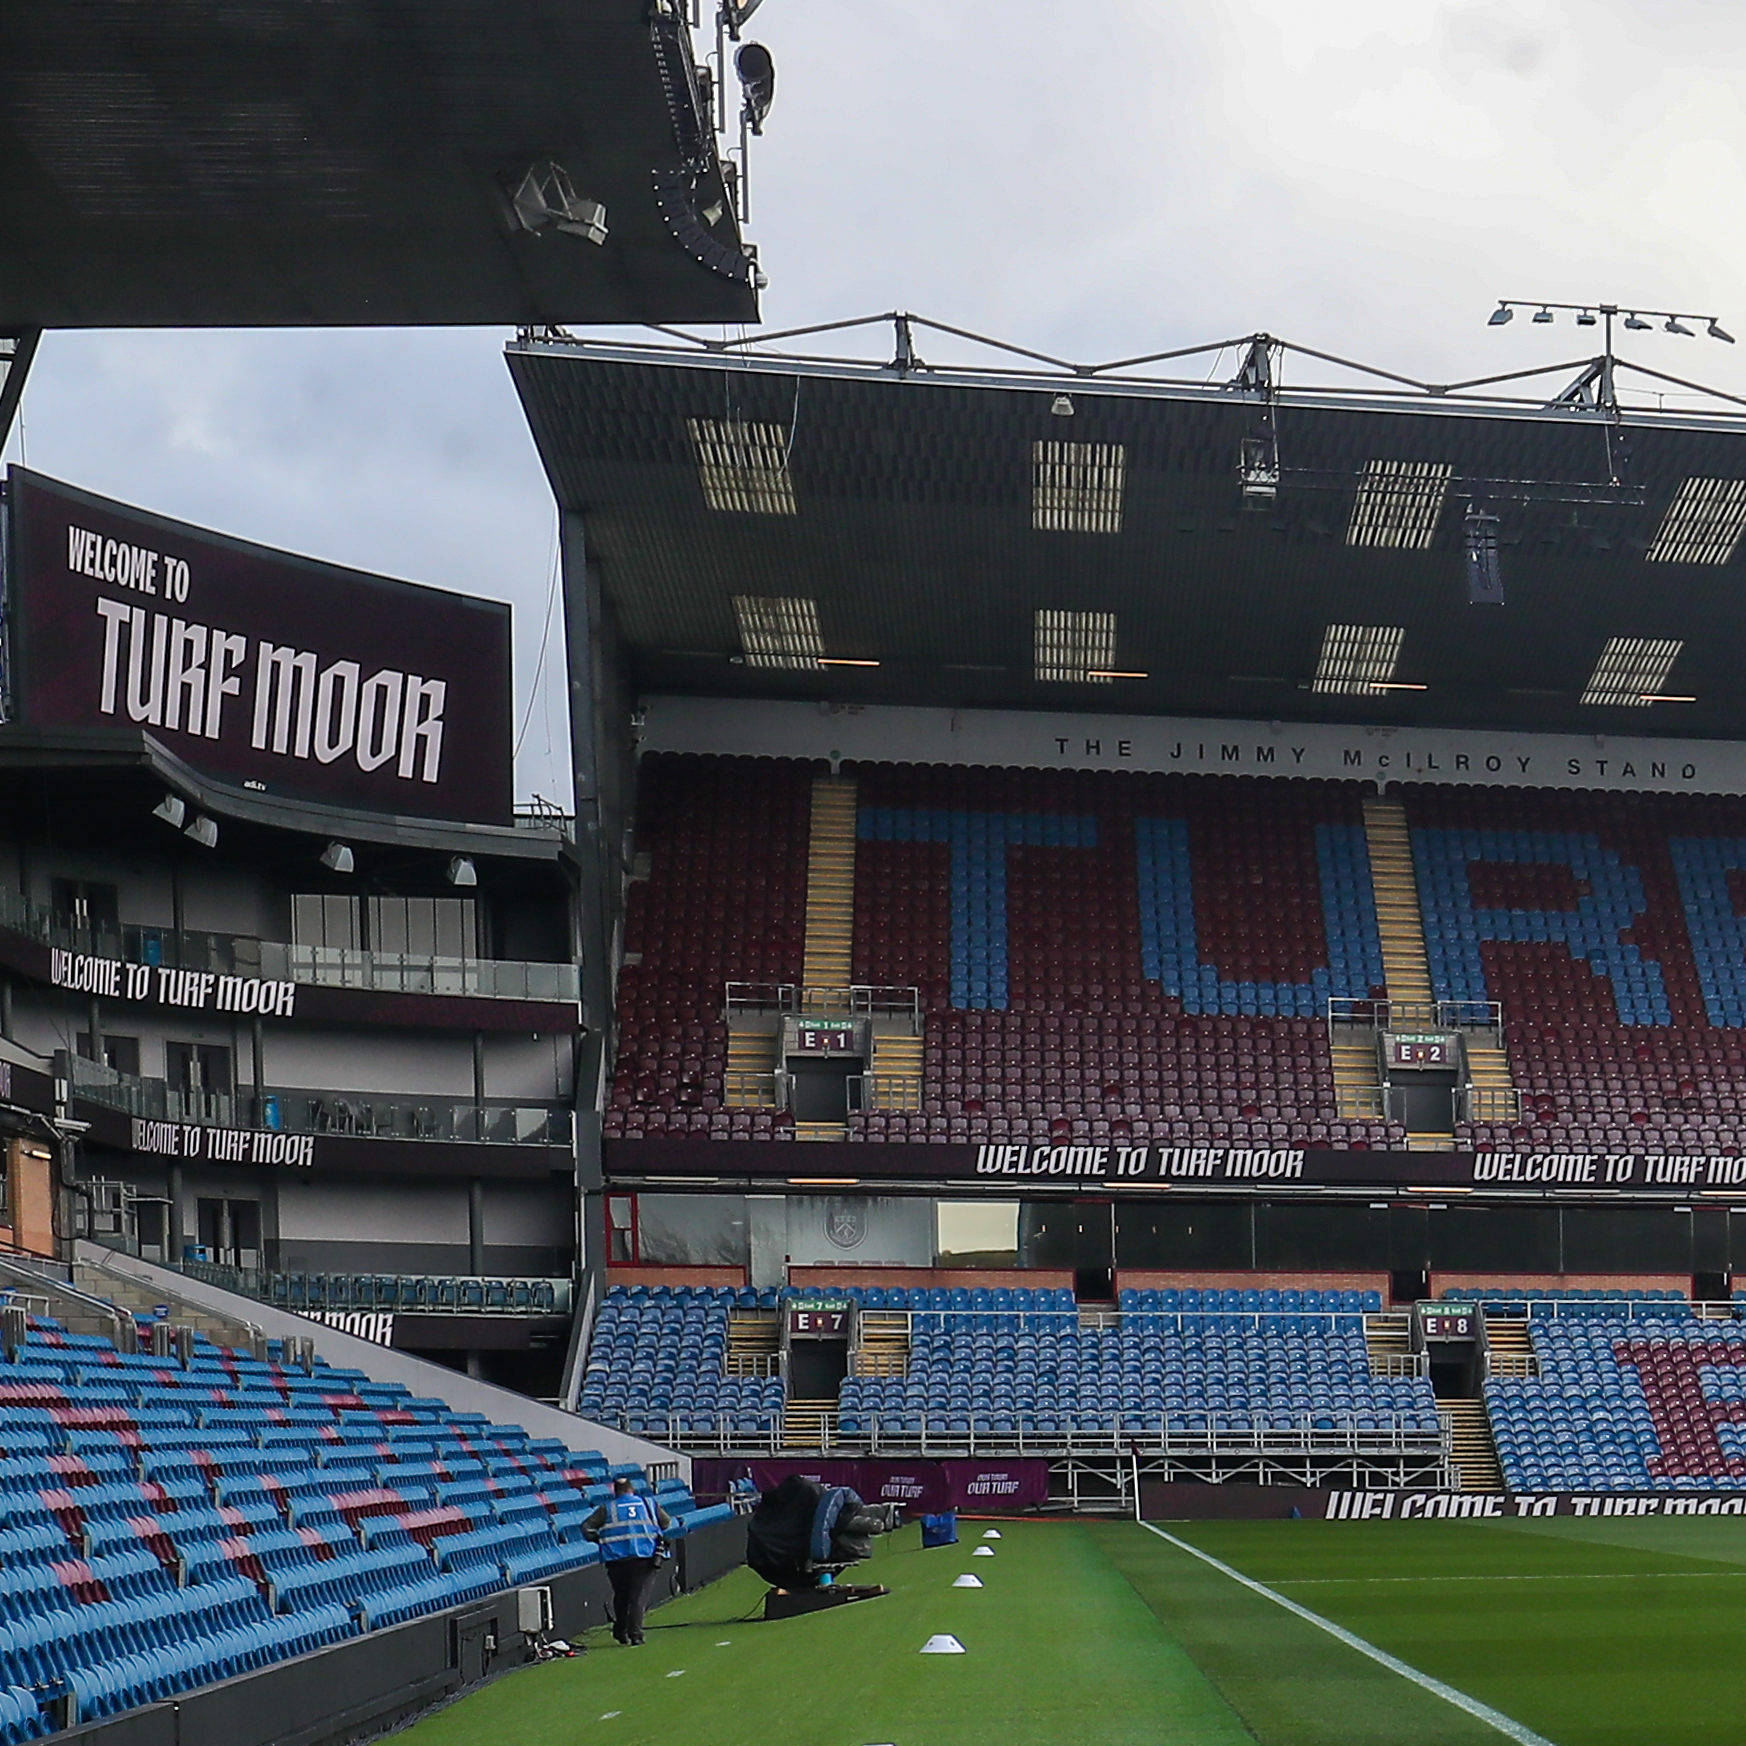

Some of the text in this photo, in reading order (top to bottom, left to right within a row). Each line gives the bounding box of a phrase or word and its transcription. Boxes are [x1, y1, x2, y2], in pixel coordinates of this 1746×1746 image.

[68, 525, 190, 602] WELCOME TO
[97, 597, 446, 783] TURF MOOR
[1055, 738, 1132, 757] THE
[1170, 743, 1305, 763] JIMMY
[1568, 758, 1696, 779] STAND
[51, 947, 296, 1017] WELCOME TO TURF MOOR
[805, 1032, 845, 1048] E 1
[1401, 1045, 1440, 1061] E 2
[132, 1117, 315, 1166] WELCOME TO TURF MOOR
[976, 1145, 1304, 1177] WELCOME TO TURF MOOR
[1473, 1153, 1599, 1182] WELCOME
[1605, 1154, 1634, 1183] TO
[1644, 1155, 1705, 1183] TURF
[798, 1313, 843, 1330] E 7
[1426, 1318, 1467, 1334] E 8
[967, 1480, 1019, 1495] OUR TURF
[628, 1506, 637, 1518] 3
